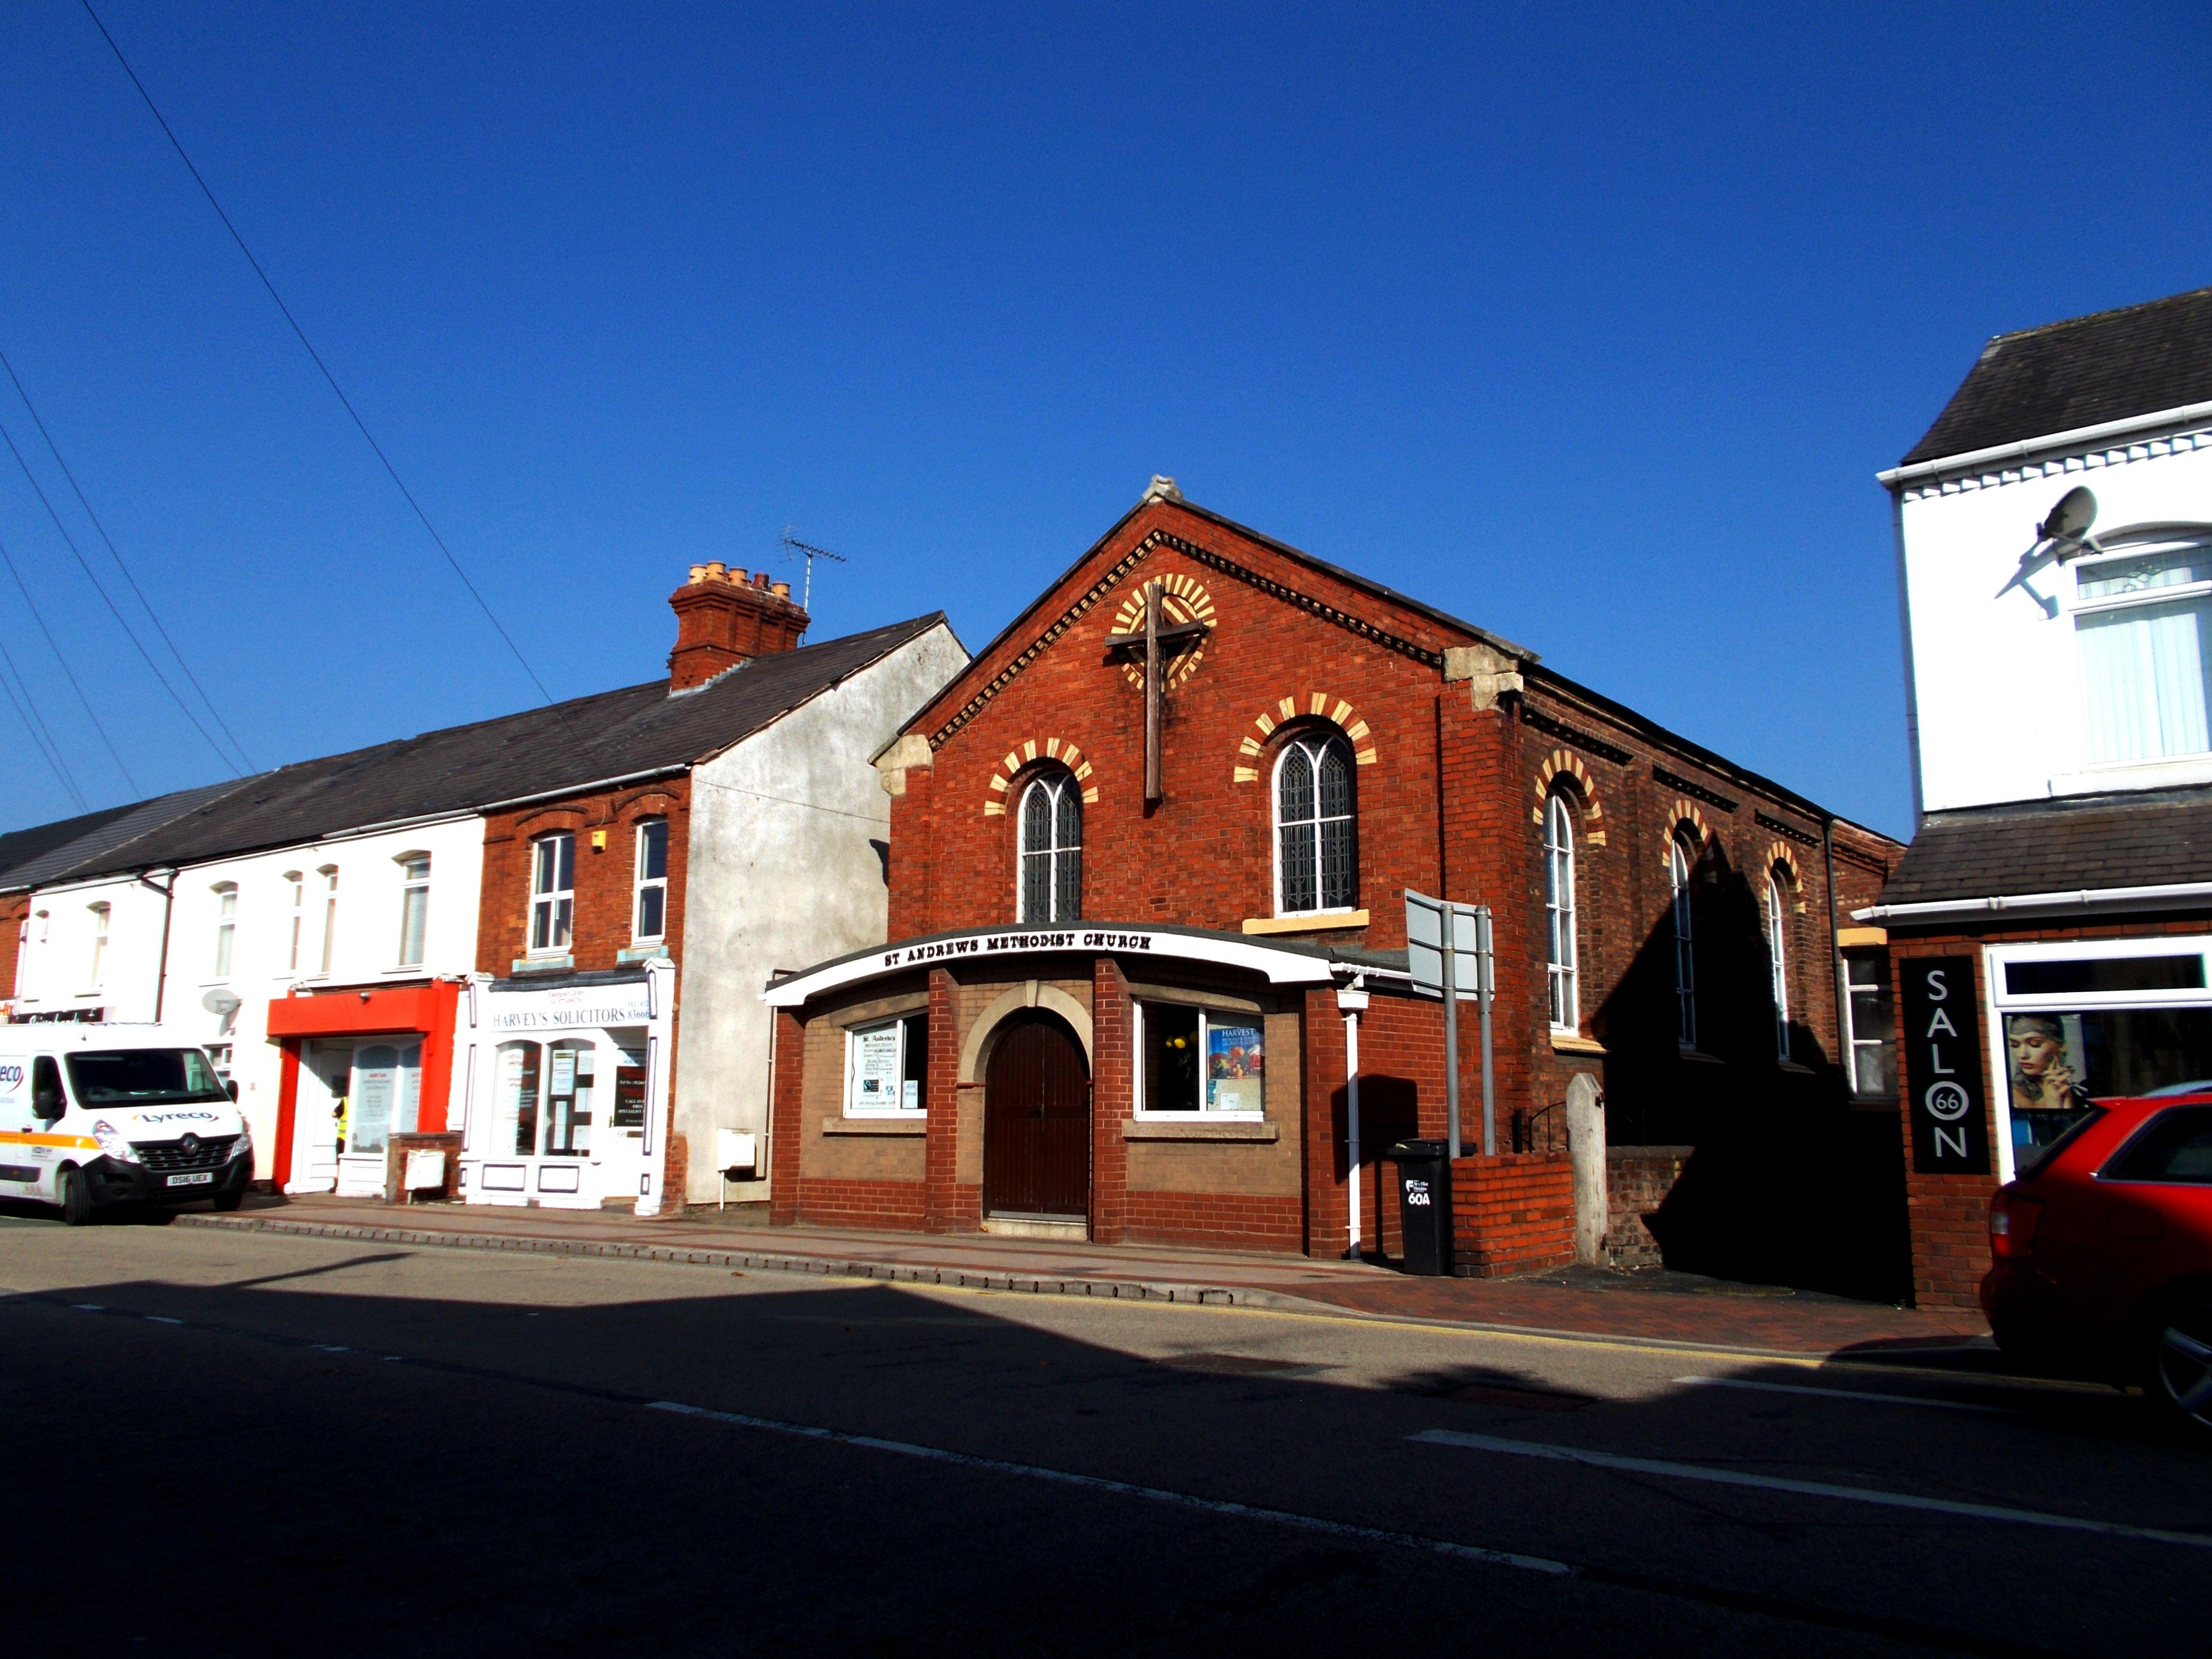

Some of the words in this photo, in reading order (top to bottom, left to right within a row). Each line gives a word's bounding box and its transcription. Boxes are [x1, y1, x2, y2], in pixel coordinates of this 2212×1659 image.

[885, 952, 900, 966] ST
[907, 939, 978, 962] ANDREWS
[987, 934, 1075, 951] METHODIST
[1084, 933, 1151, 950] CHURCH
[493, 1012, 548, 1027] HARVEY'S
[553, 1007, 625, 1025] SOLICITORS
[1222, 1028, 1255, 1037] HARVEST
[1925, 970, 1969, 1157] SALON
[0, 1065, 21, 1082] eco
[1936, 1093, 1959, 1110] 66
[142, 1113, 212, 1123] Lyreco
[172, 1175, 191, 1184] DS16
[193, 1174, 208, 1182] UEX
[1408, 1193, 1430, 1205] 60A
